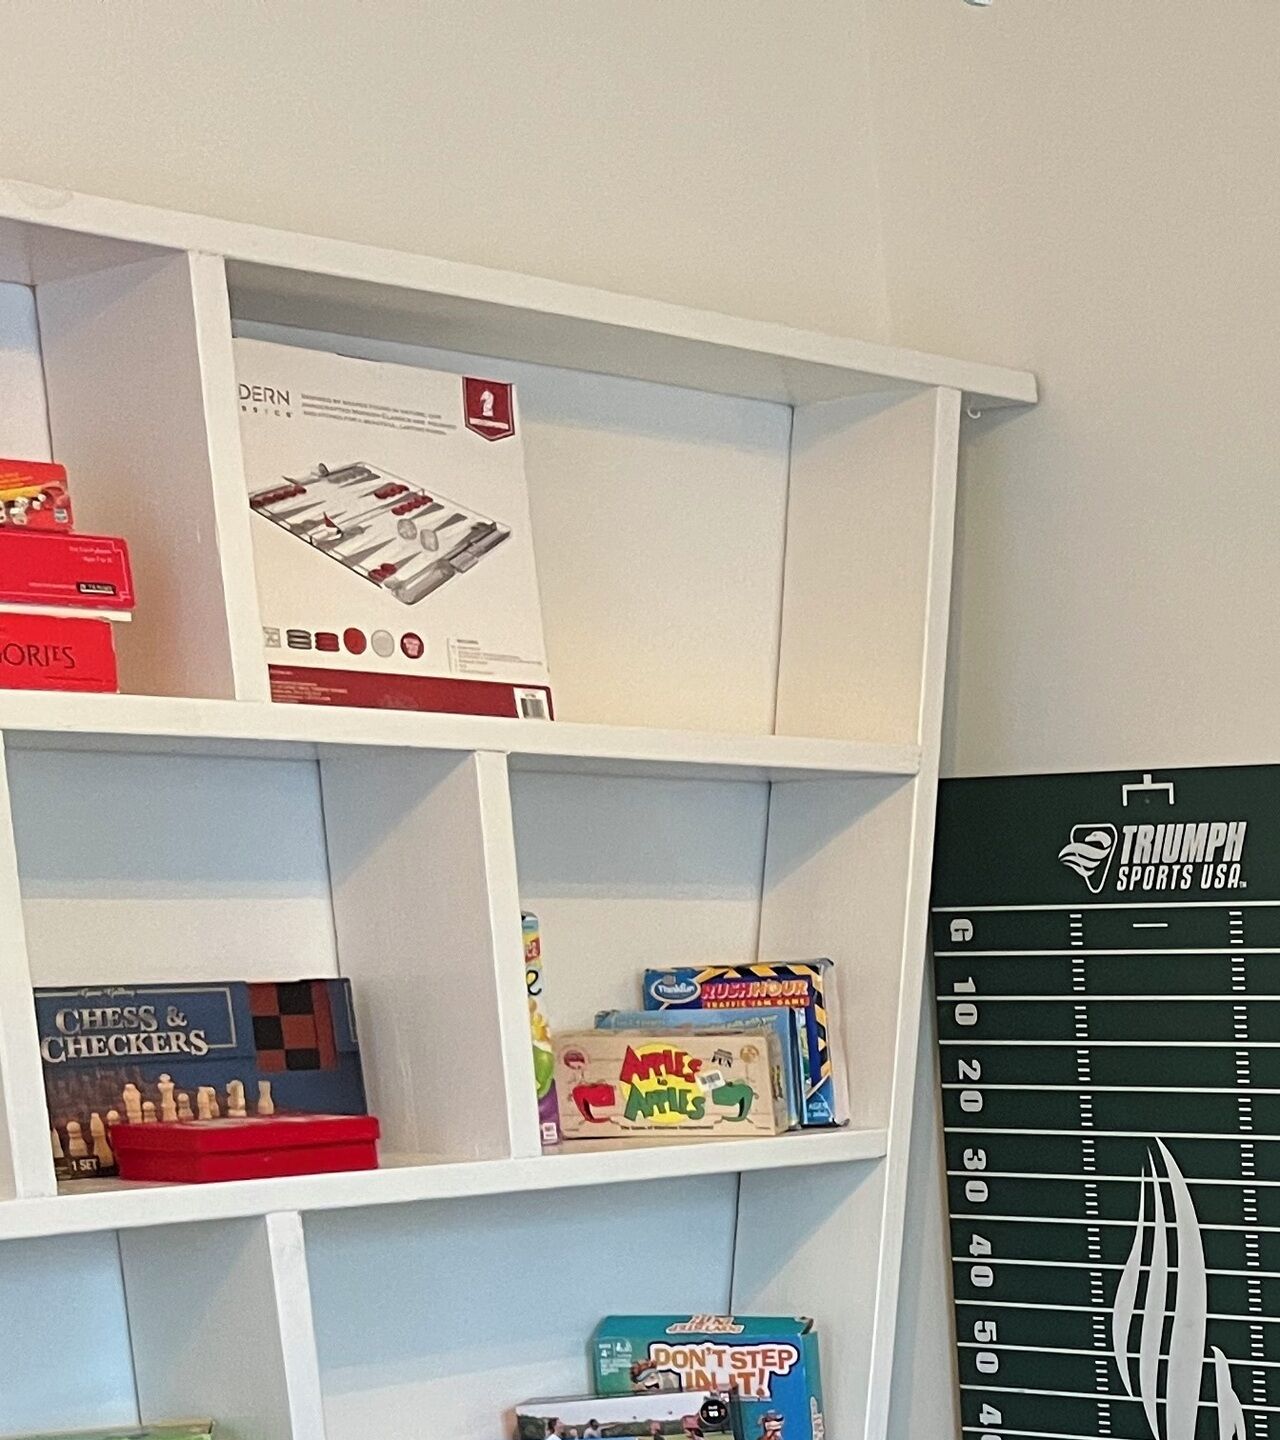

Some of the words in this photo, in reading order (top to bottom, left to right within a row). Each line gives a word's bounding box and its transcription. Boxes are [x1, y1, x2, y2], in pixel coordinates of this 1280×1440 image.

[0, 642, 76, 669] ORIES
[1120, 821, 1248, 866] TRIUMPH
[1116, 863, 1193, 892] SPORTS
[1200, 862, 1241, 890] USA
[949, 918, 974, 943] G
[952, 976, 979, 1028] 10
[55, 1005, 159, 1035] CHESS
[166, 1005, 188, 1027] &
[40, 1029, 210, 1063] CHECKERS
[957, 1058, 983, 1113] 20
[71, 1159, 78, 1172] 1
[79, 1158, 98, 1172] SET
[963, 1147, 989, 1203] 30
[969, 1233, 994, 1288] 40
[654, 1346, 728, 1369] DON'T
[730, 1348, 794, 1370] STEP
[973, 1320, 999, 1375] 50
